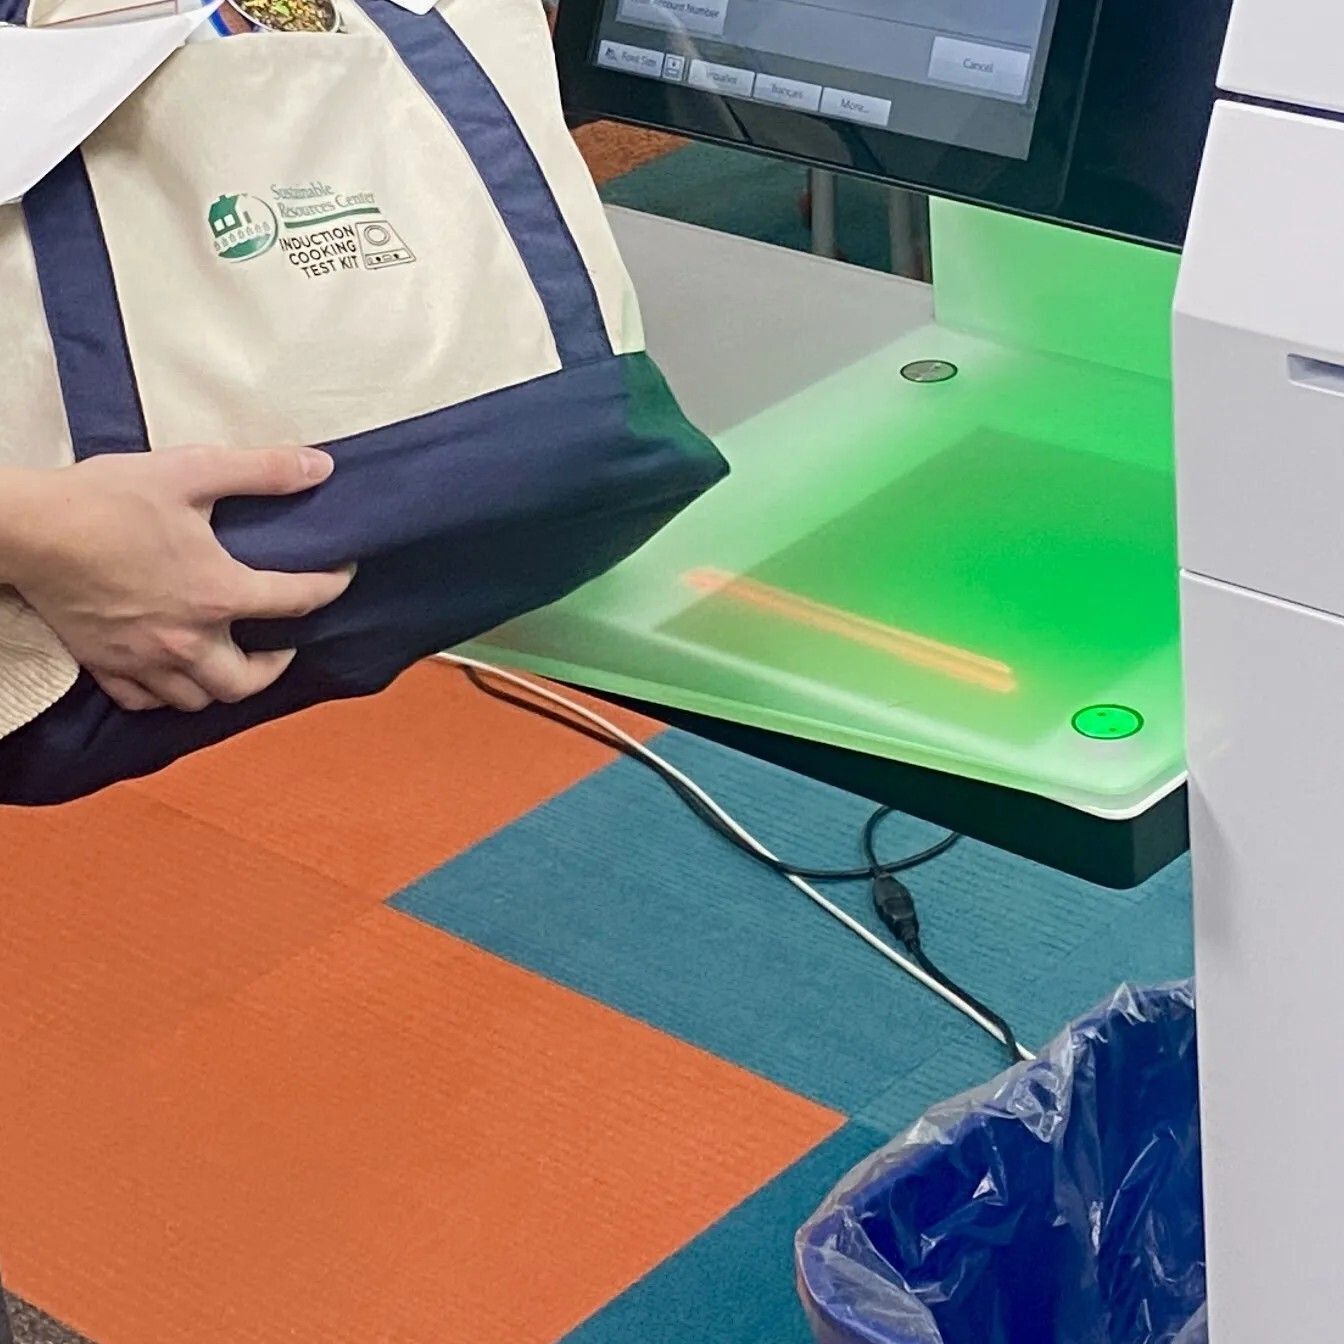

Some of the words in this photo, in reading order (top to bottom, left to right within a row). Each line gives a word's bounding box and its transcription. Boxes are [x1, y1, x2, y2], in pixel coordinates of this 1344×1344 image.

[962, 57, 994, 74] Cancel
[270, 181, 335, 201] Sustainable
[276, 201, 336, 218] Resources
[334, 191, 376, 208] Center
[278, 224, 355, 252] INDUCTION
[289, 240, 357, 266] COOKING
[301, 259, 337, 279] TEST
[339, 256, 359, 269] KIT
